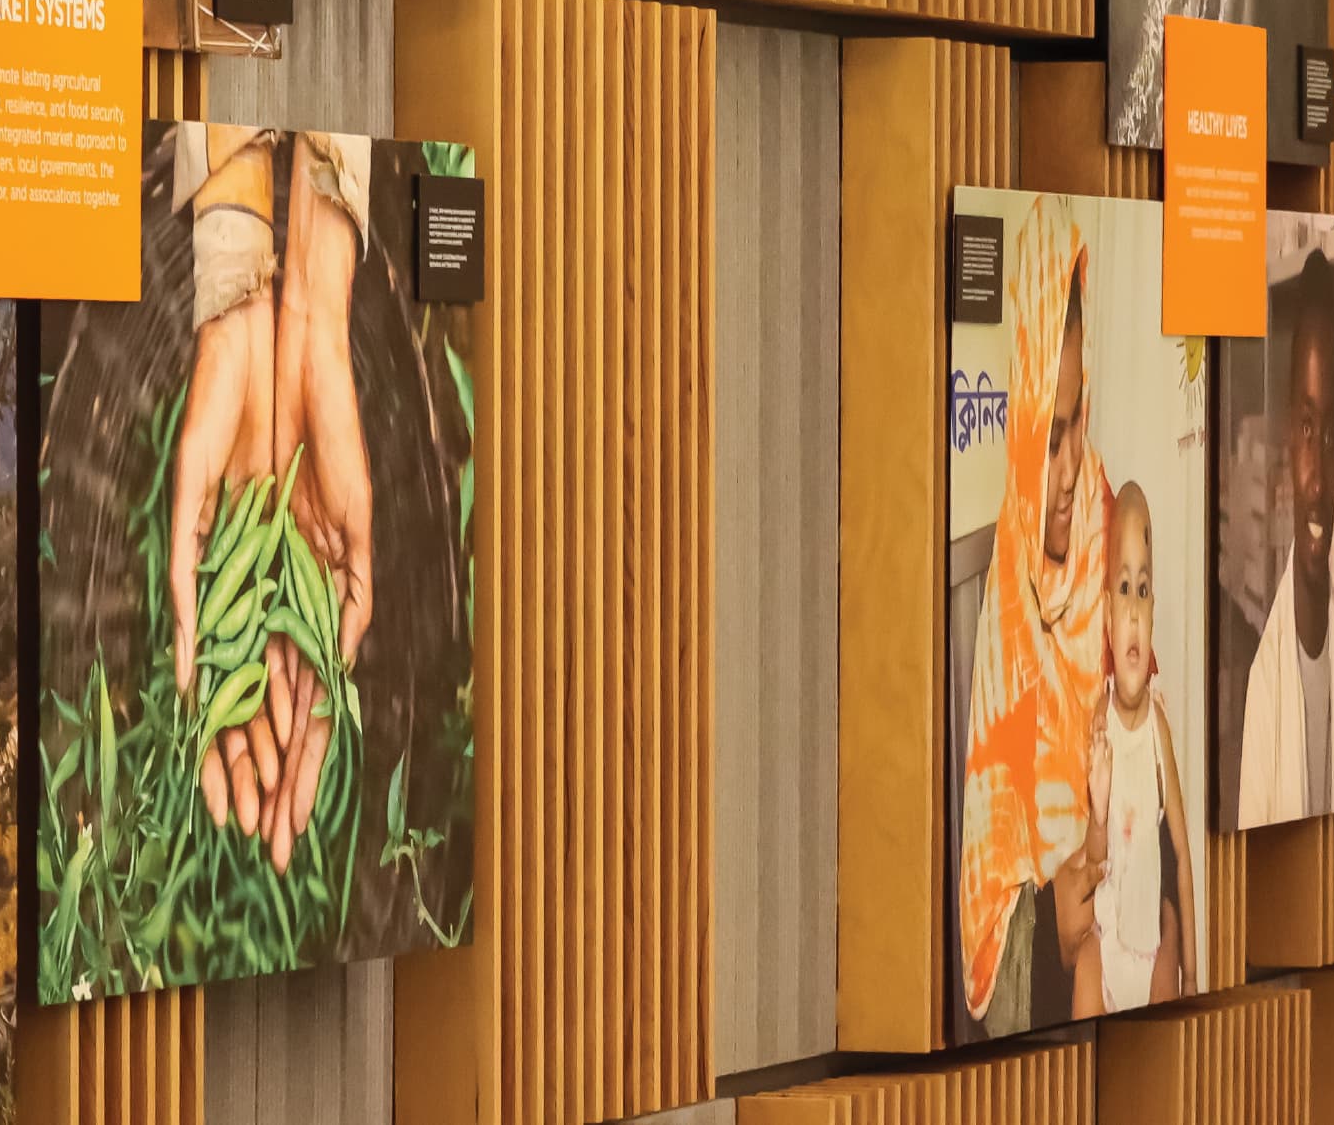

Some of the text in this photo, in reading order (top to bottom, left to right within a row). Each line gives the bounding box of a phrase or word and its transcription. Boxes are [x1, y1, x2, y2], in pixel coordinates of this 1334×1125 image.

[22, 67, 51, 92] lasting
[53, 72, 101, 92] agricultural
[50, 100, 66, 117] and
[68, 98, 88, 120] food
[1187, 109, 1248, 140] HEALTHY LIVES
[43, 129, 73, 148] market
[76, 132, 116, 151] approach
[118, 134, 127, 152] to
[17, 154, 38, 174] local
[100, 161, 114, 179] the
[10, 184, 27, 202] and
[29, 186, 81, 204] associations
